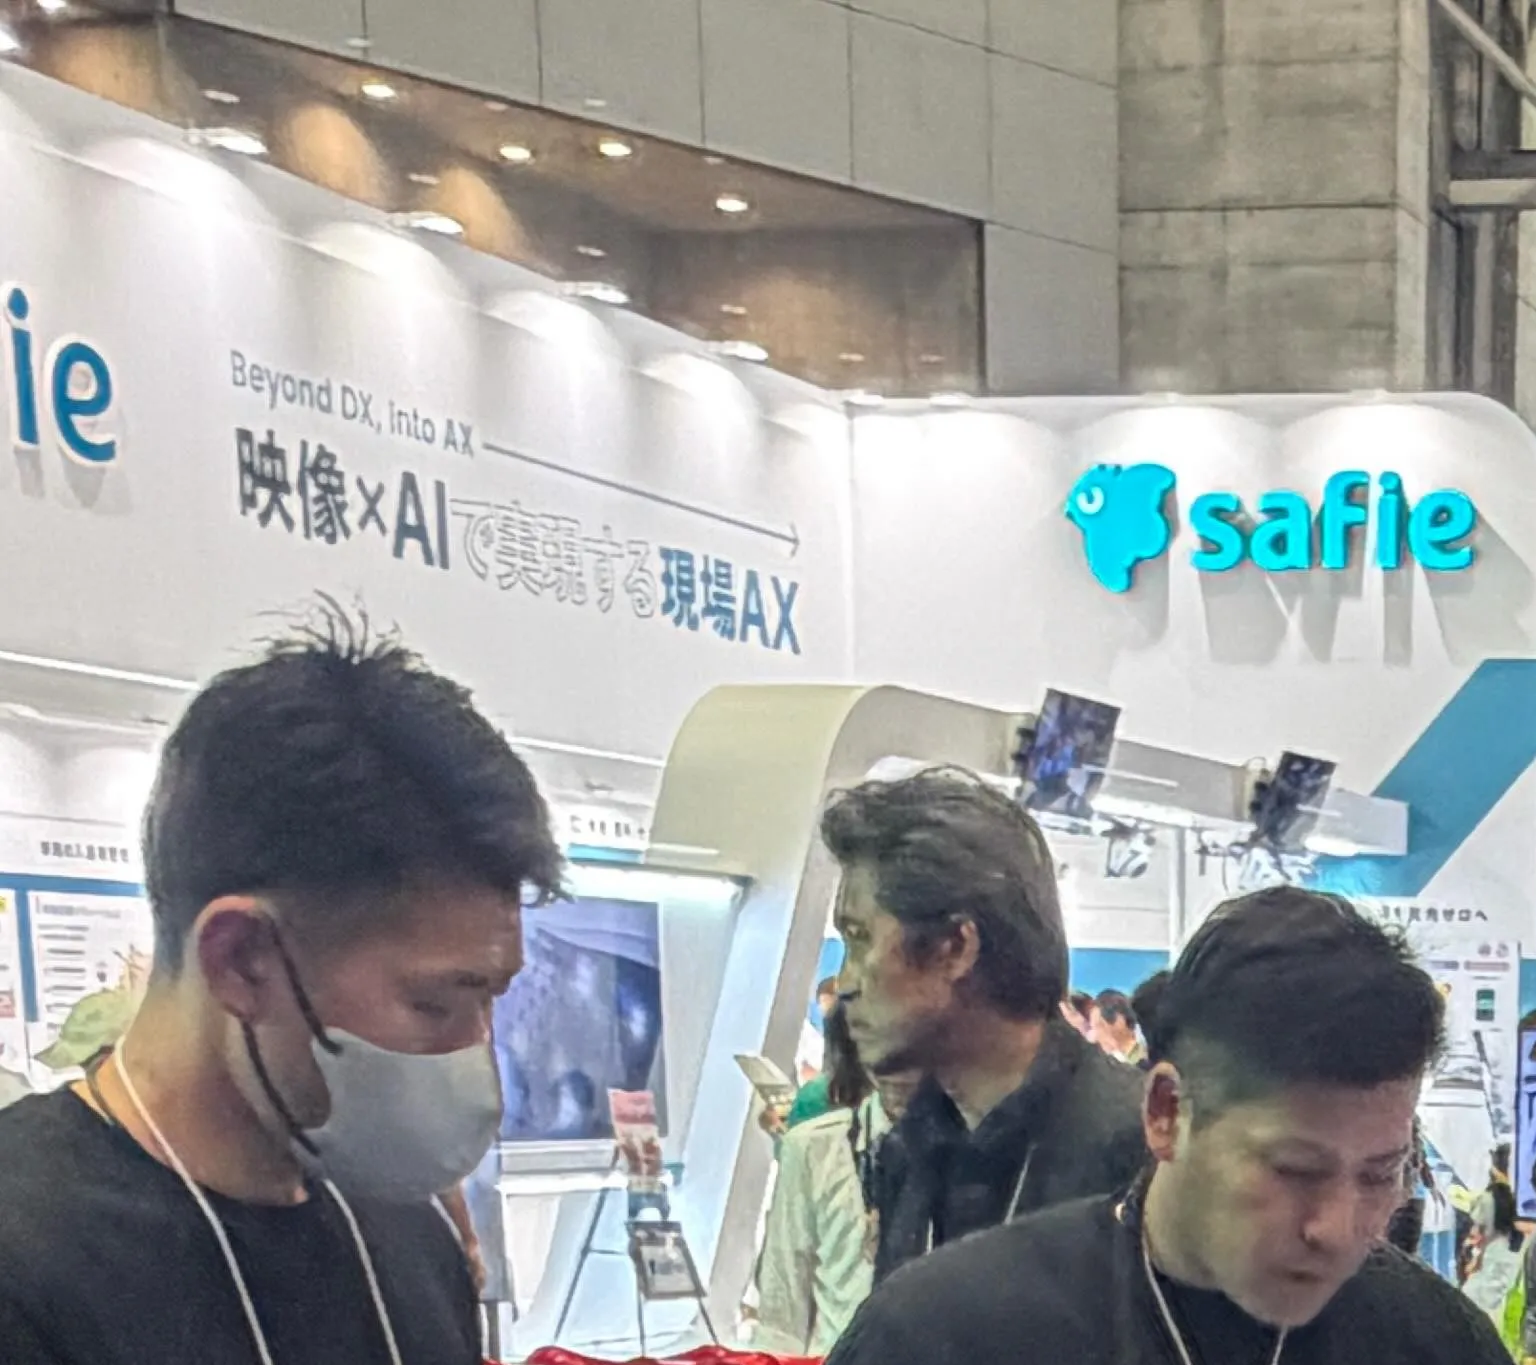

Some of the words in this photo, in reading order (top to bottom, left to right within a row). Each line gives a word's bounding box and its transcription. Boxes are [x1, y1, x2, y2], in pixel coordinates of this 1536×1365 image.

[230, 350, 332, 413] Beyond
[340, 384, 383, 435] DX,
[443, 421, 475, 459] AX
[1189, 469, 1478, 571] safie
